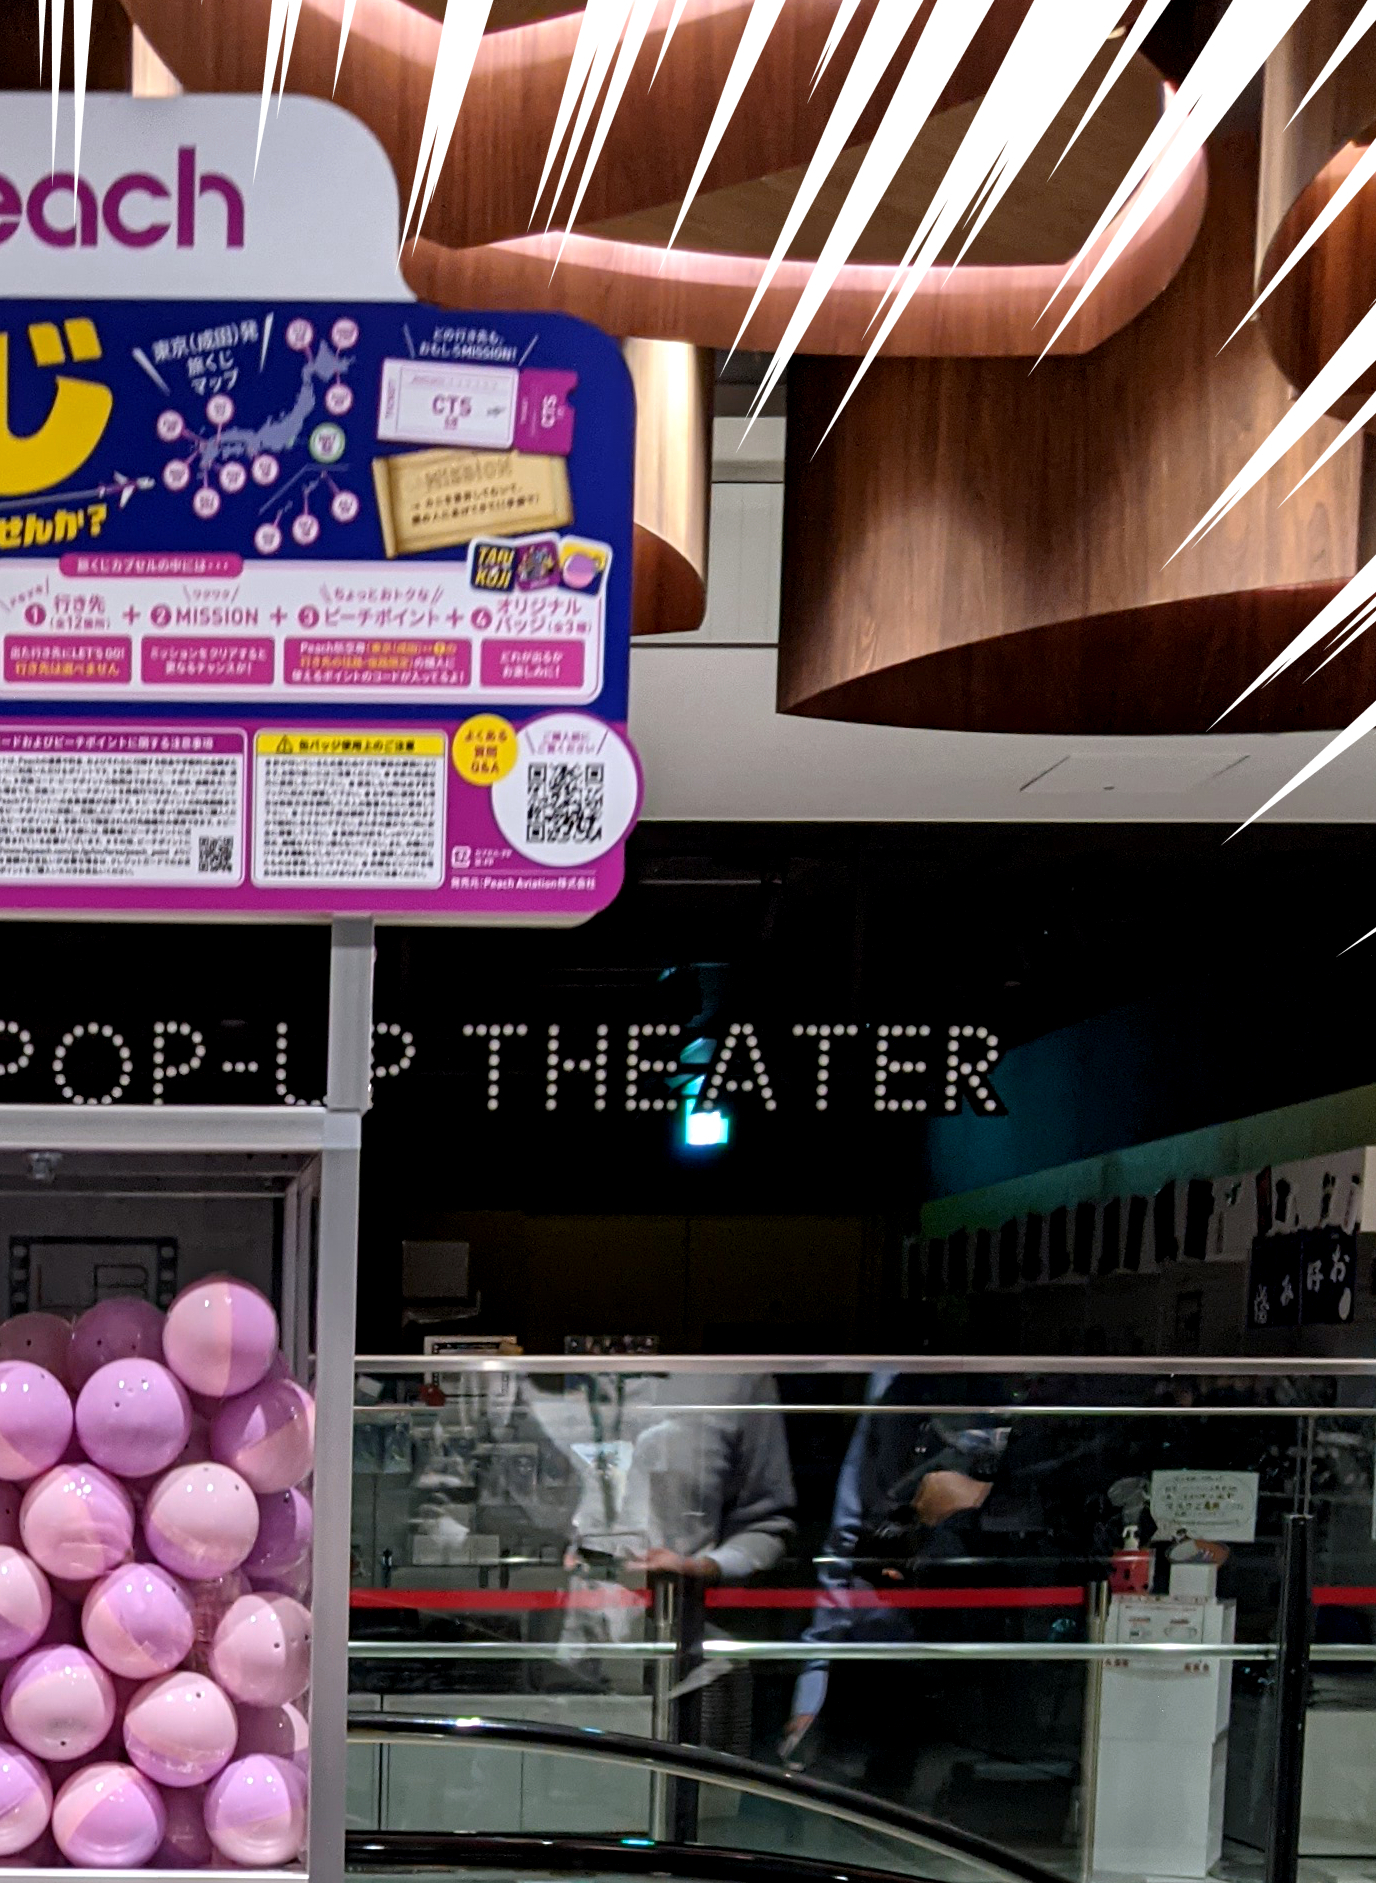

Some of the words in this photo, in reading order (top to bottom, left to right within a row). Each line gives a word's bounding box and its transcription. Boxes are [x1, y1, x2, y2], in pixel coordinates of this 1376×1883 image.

[191, 367, 239, 396] マップ
[432, 393, 473, 416] CTS
[54, 593, 106, 614] 行き先
[497, 598, 582, 616] オリジナル
[176, 607, 259, 627] MISSION
[324, 606, 440, 627] ピーチポイント
[471, 760, 500, 775] Q&A
[462, 1022, 1000, 1112] THEATER
